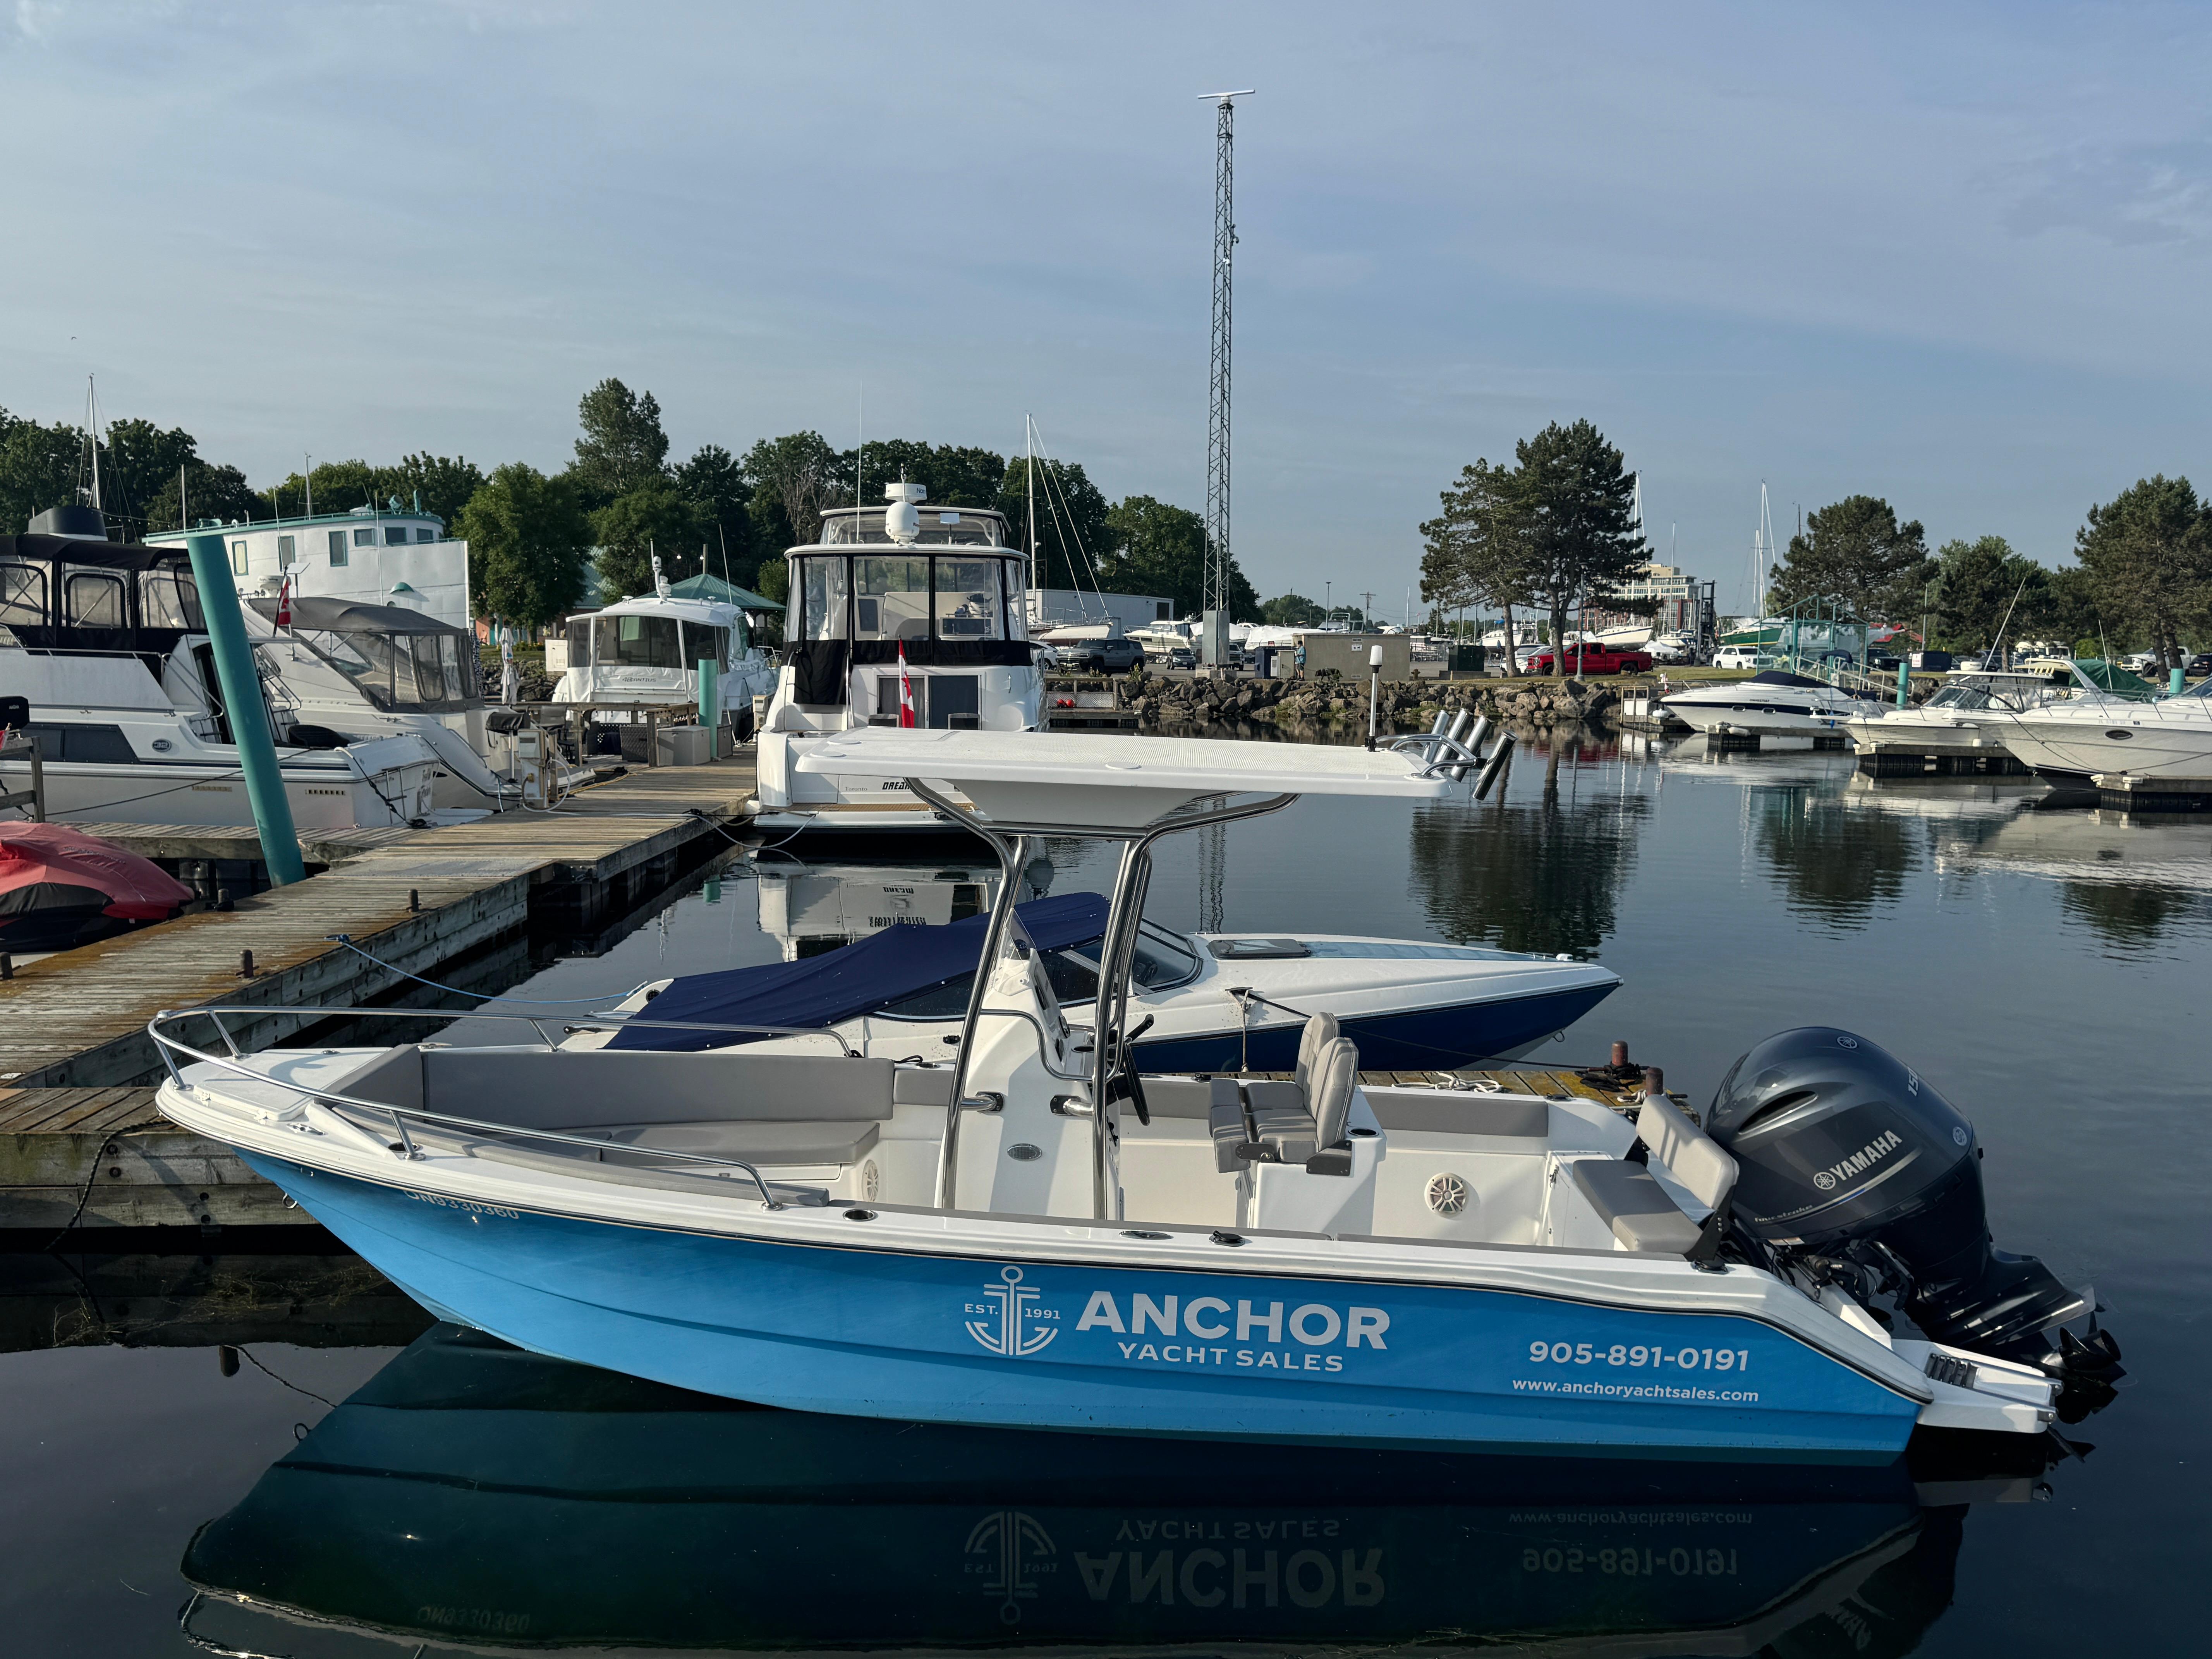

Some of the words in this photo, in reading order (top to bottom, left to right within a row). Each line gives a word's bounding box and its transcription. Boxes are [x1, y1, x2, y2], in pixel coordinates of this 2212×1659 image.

[1829, 1130, 1903, 1181] YAMAHA
[965, 1304, 998, 1315] EST.
[1025, 1308, 1060, 1319] 1991
[1075, 1291, 1390, 1349] ANCHOR
[1118, 1342, 1228, 1364] YACHT
[1236, 1350, 1343, 1372] SALES
[1530, 1341, 1748, 1371] 905-891-0191
[1513, 1380, 1759, 1401] www.anchoryachtsales.com
